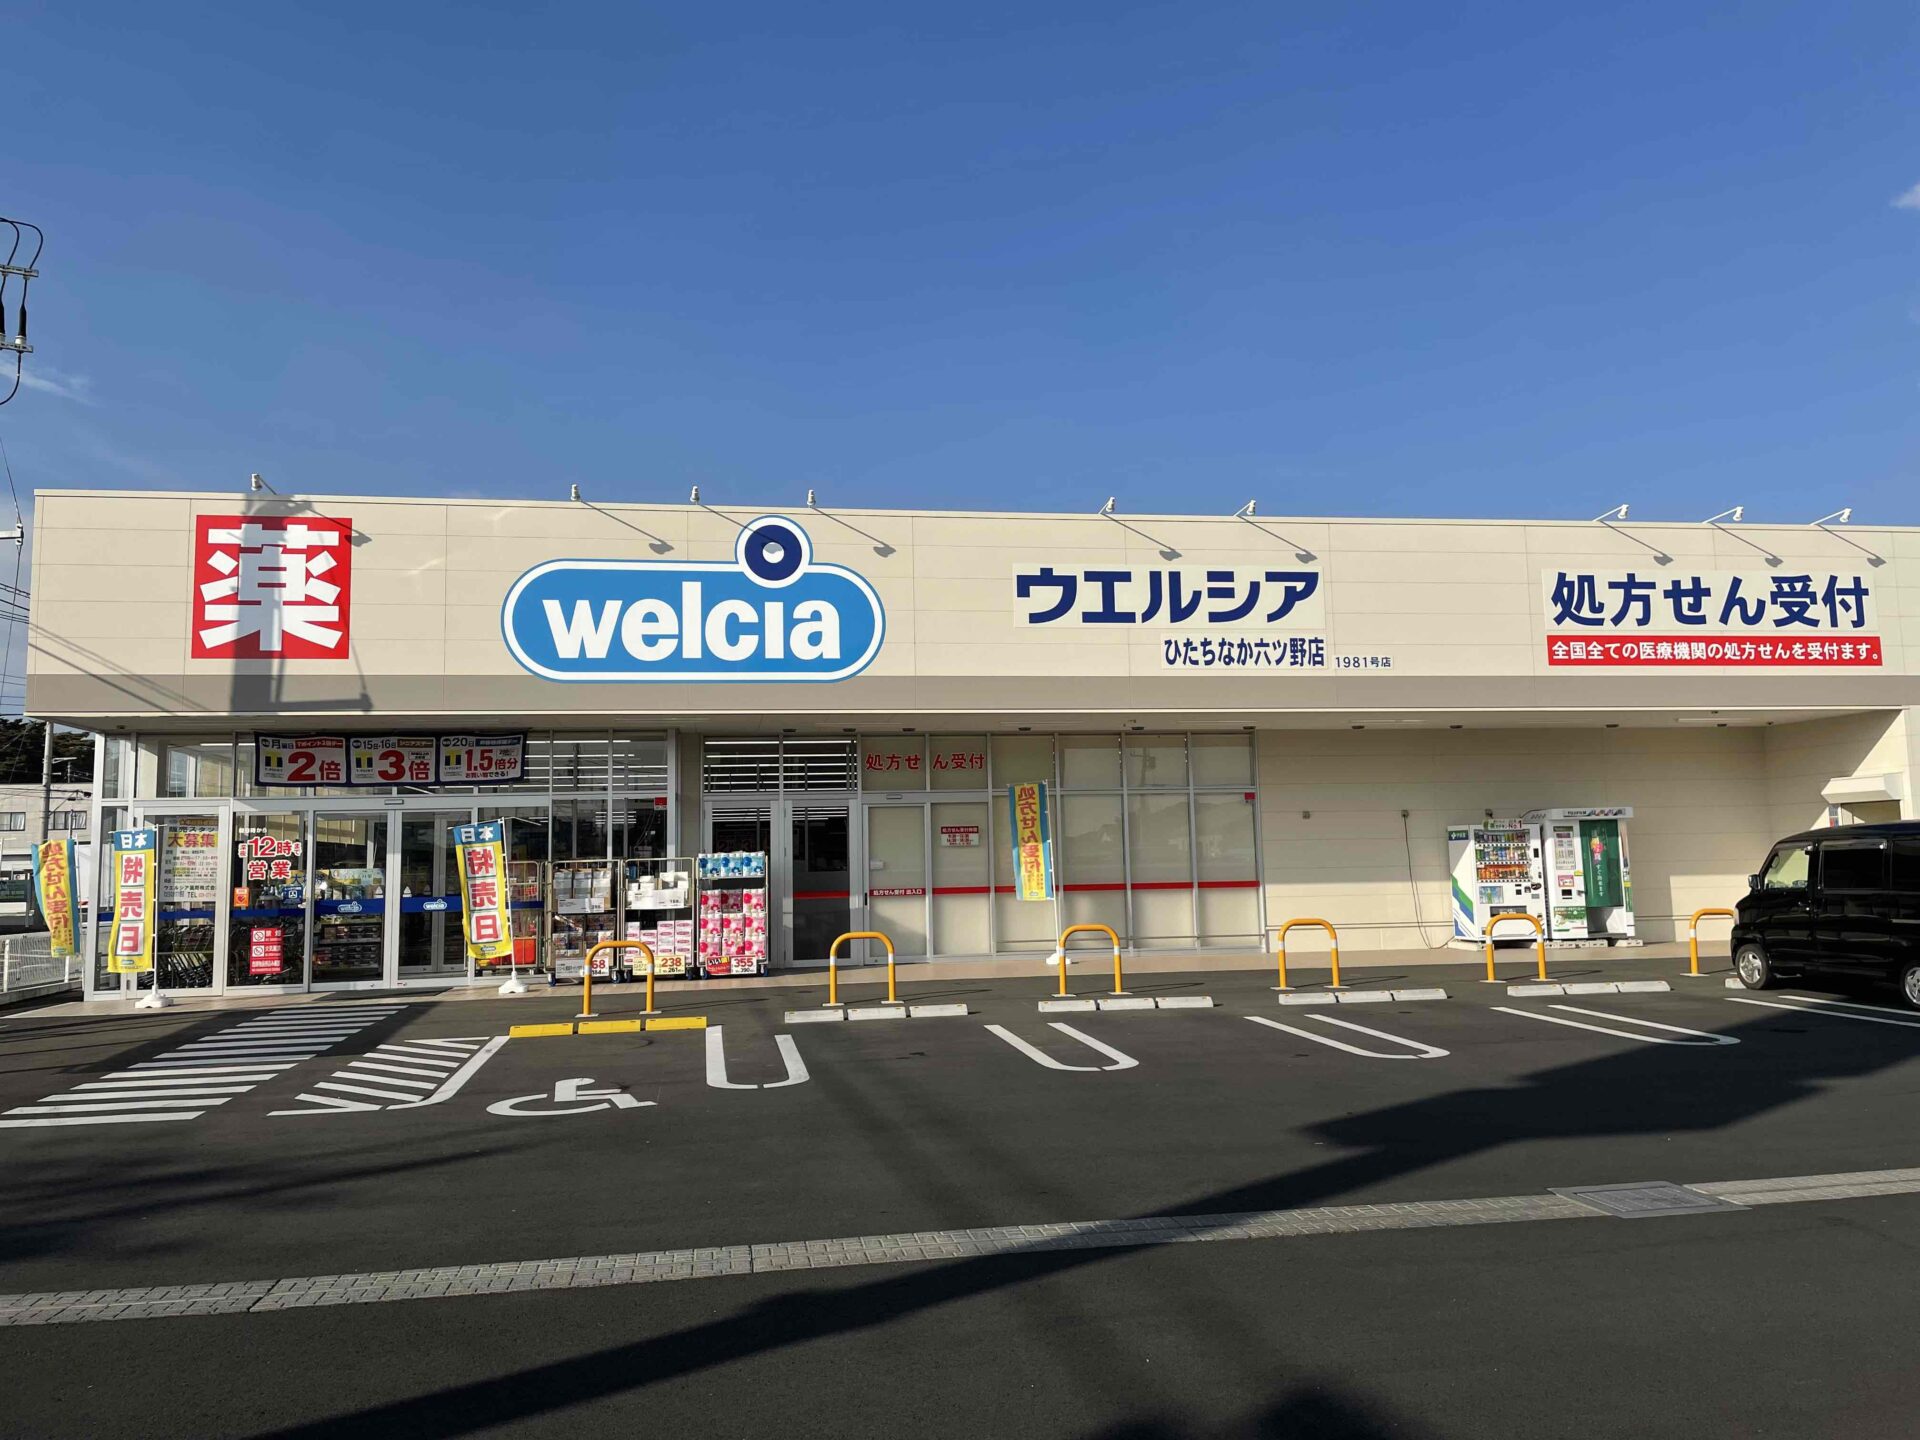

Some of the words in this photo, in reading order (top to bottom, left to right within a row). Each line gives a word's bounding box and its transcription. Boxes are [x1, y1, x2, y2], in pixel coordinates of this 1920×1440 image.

[199, 523, 343, 651] 薬
[542, 525, 841, 661] welcia
[1016, 567, 1320, 624] ウエルシア
[1550, 572, 1870, 629] 処方せん受付
[1164, 637, 1325, 667] ひたちなか六ツ野店
[1551, 641, 1879, 661] 全国全ての医療機関の処方せんを受付ます。
[1335, 656, 1392, 668] 1981号店
[452, 738, 475, 747] 20日
[287, 751, 342, 781] 2倍
[378, 750, 430, 781] 3倍
[866, 753, 985, 770] 処方せん受付
[168, 833, 215, 848] 大募集
[248, 836, 292, 857] 12時
[248, 861, 291, 879] 営業
[661, 957, 682, 968] 238
[734, 958, 754, 968] 355
